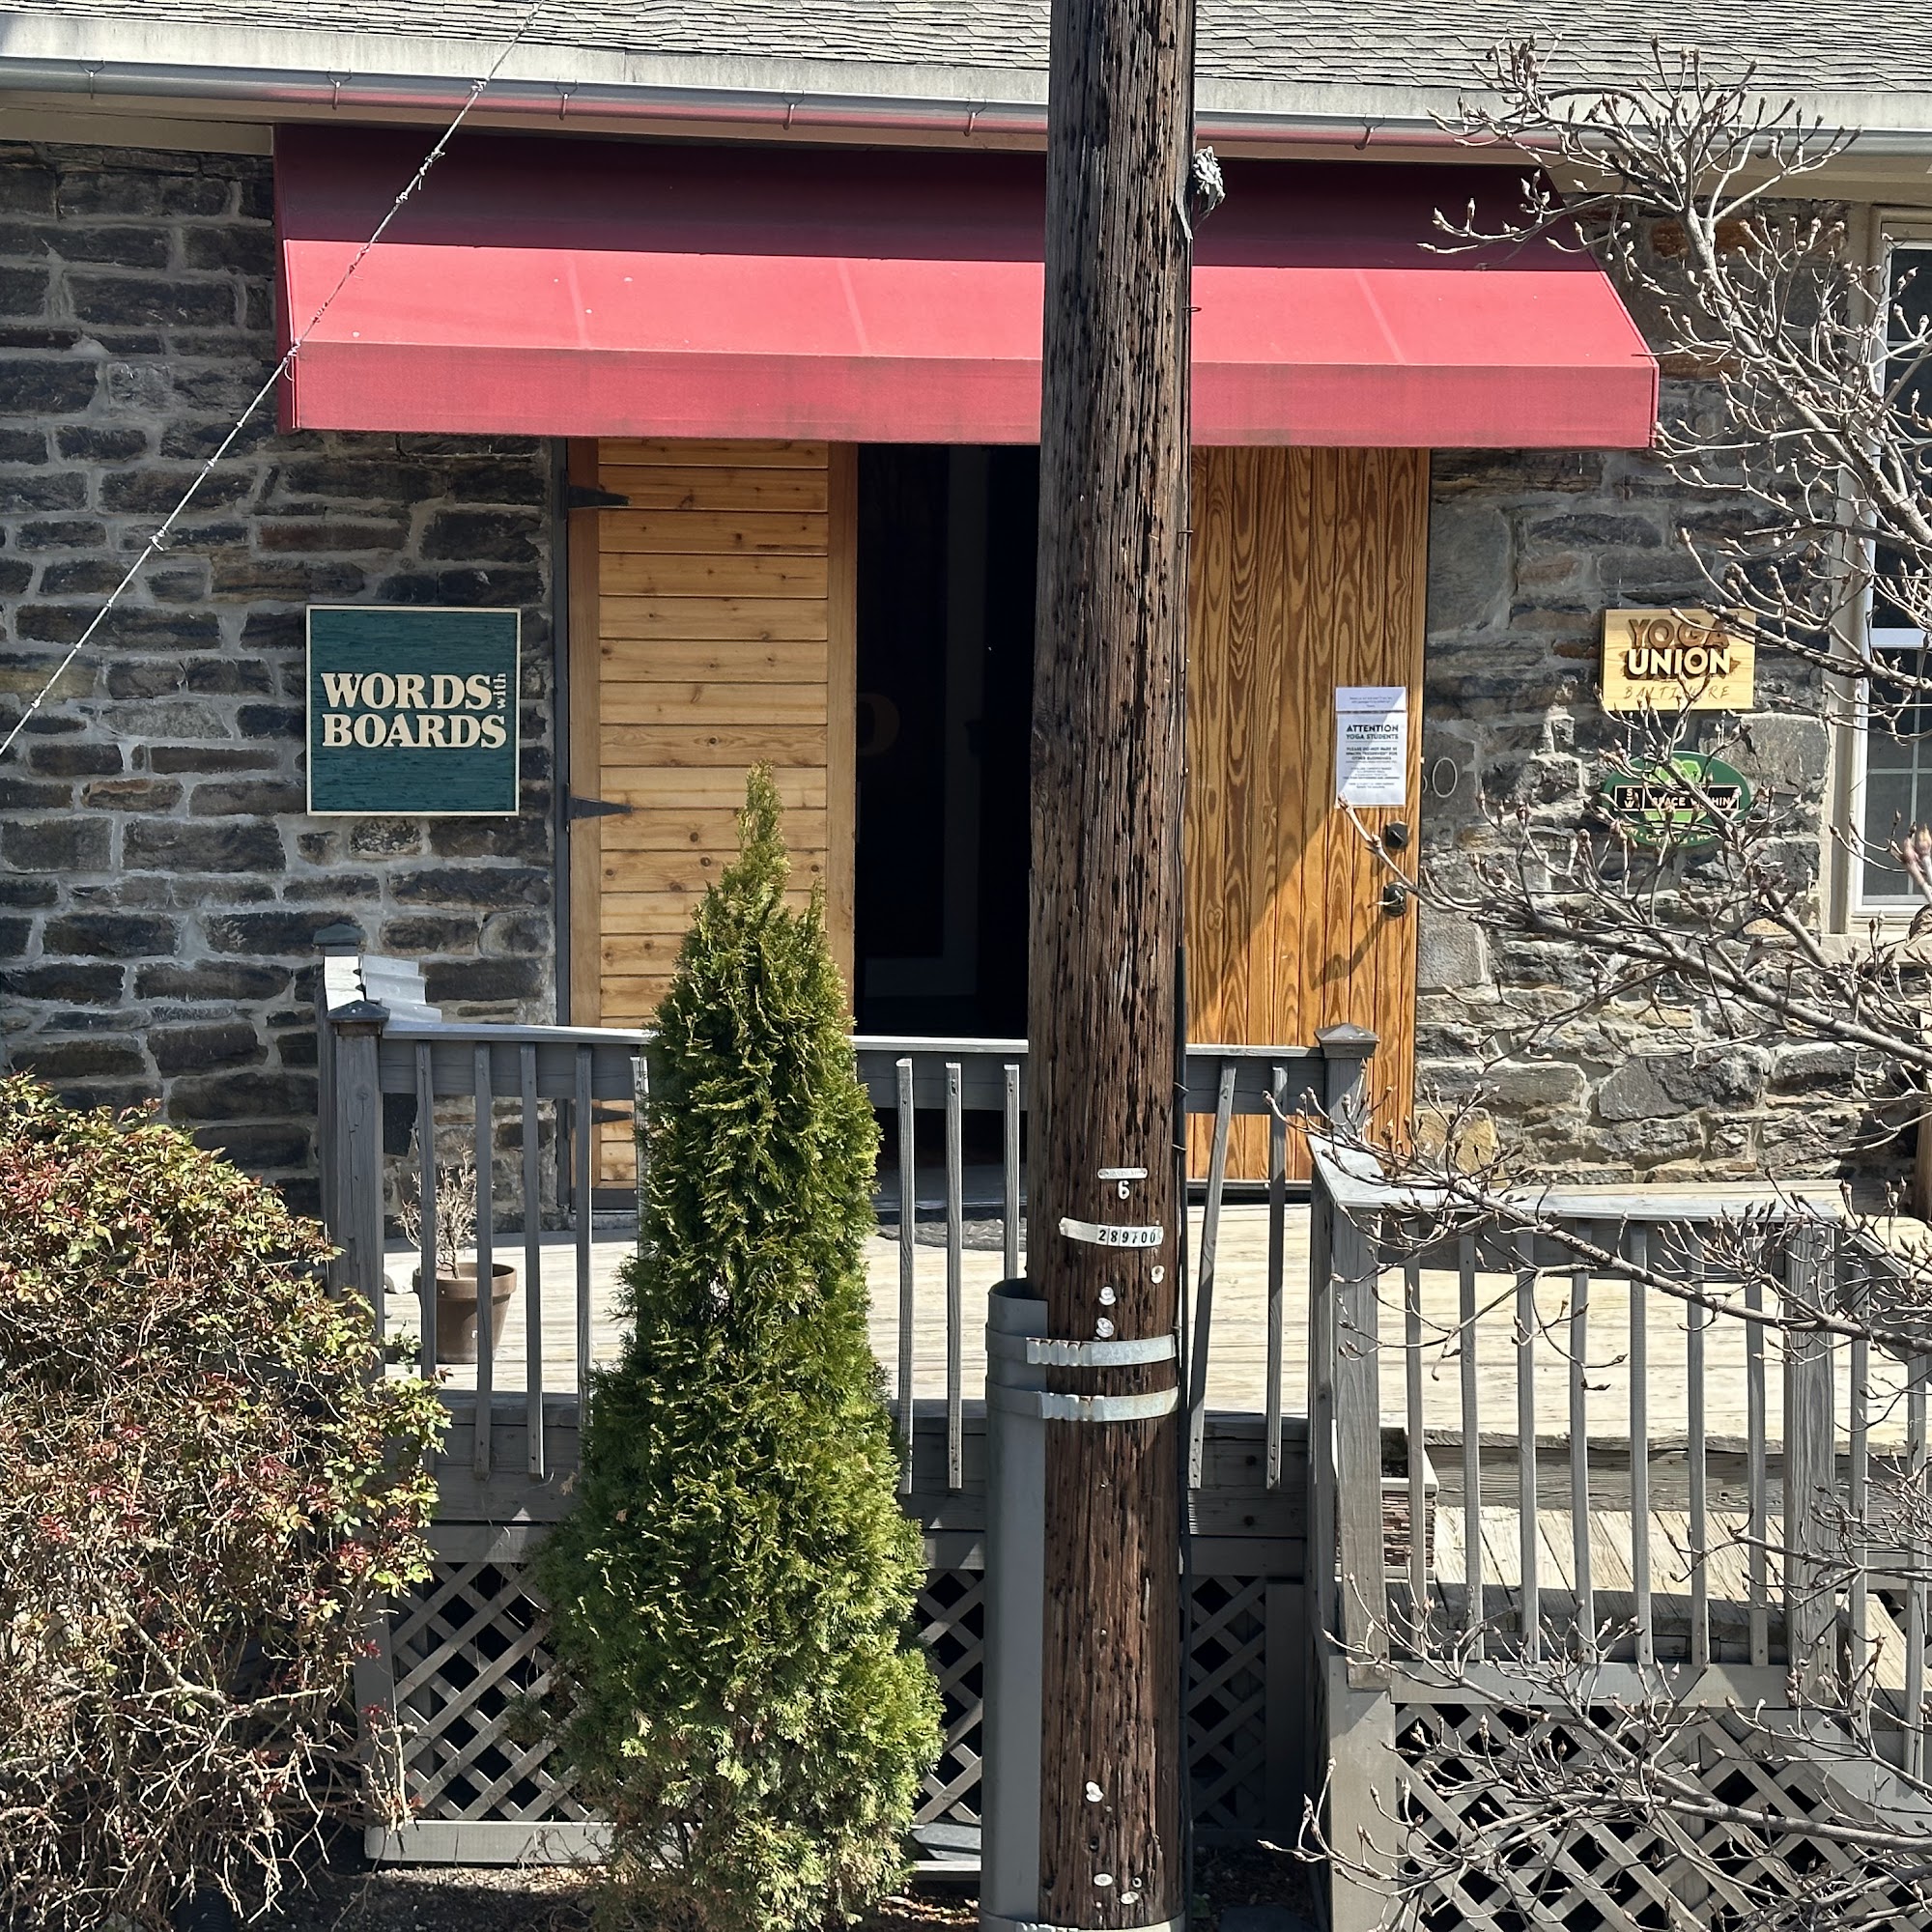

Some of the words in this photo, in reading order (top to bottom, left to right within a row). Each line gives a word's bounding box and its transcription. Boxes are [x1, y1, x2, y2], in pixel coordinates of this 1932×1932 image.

[1628, 618, 1730, 648] YOGA
[1628, 646, 1731, 676] UNION
[321, 672, 493, 710] WORDS
[493, 673, 507, 710] with
[1623, 685, 1730, 700] BALTIRE
[322, 713, 507, 749] BOARDS
[1118, 1179, 1130, 1200] 6
[1098, 1229, 1156, 1244] 289700
